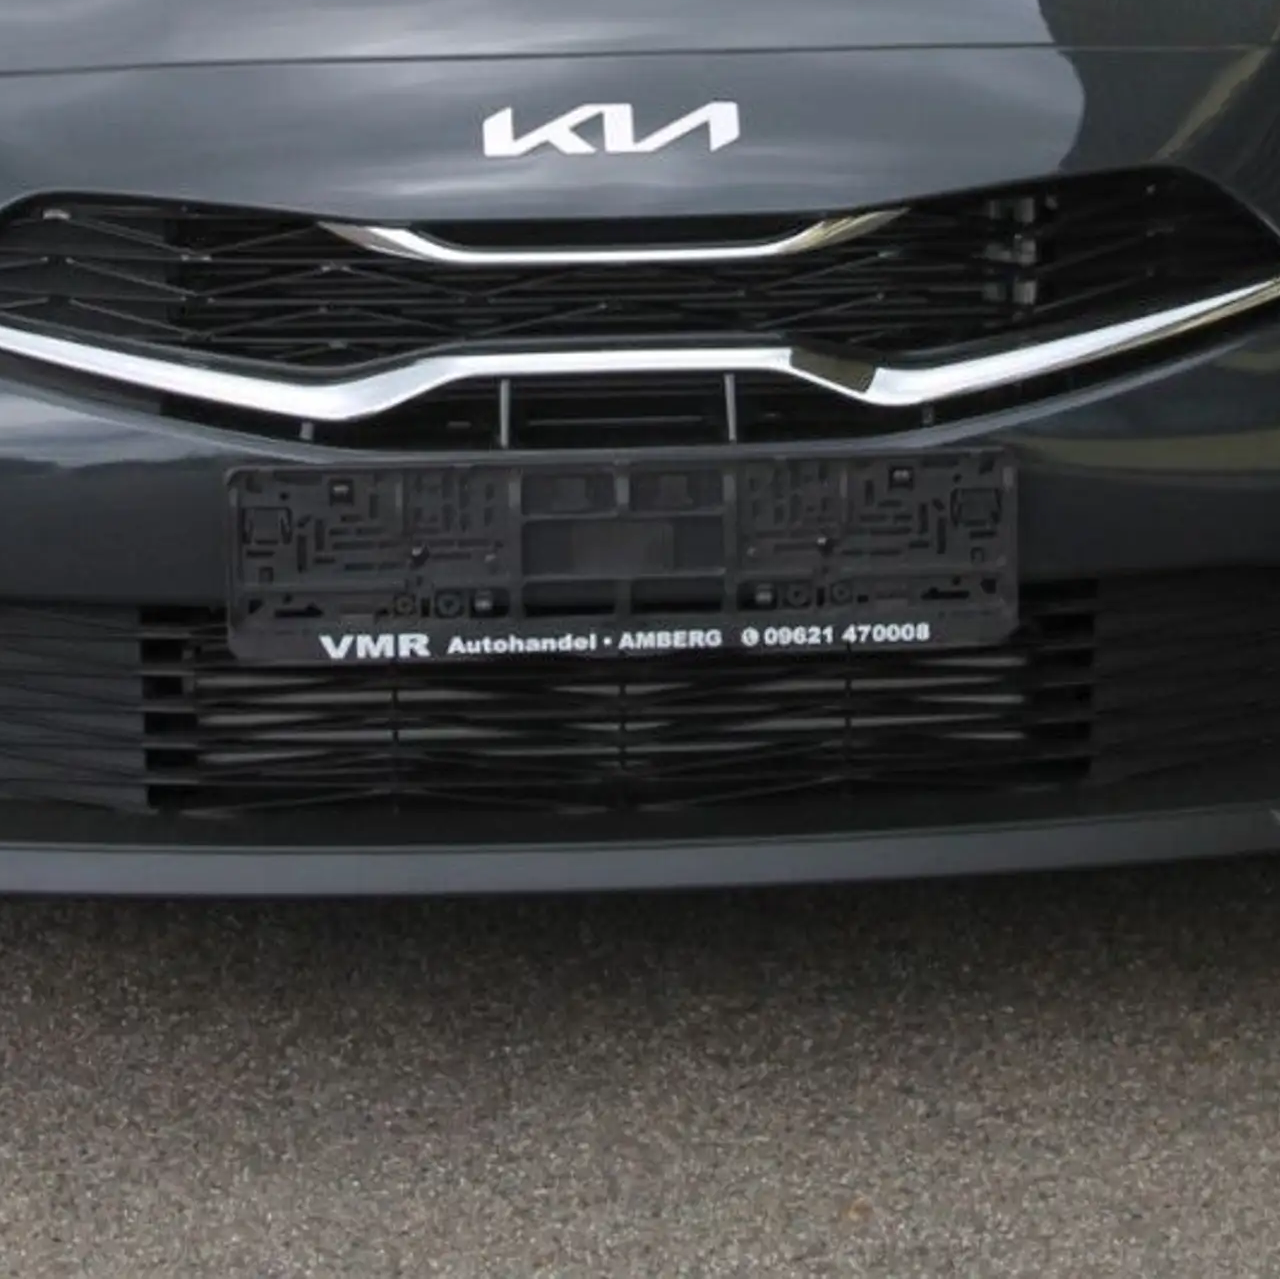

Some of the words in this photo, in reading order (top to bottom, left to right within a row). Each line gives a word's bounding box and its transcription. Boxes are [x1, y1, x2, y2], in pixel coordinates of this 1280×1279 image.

[319, 632, 432, 660] VMR
[446, 631, 597, 656] Autohandel
[618, 628, 723, 651] AMBERG
[841, 622, 931, 644] 470008
